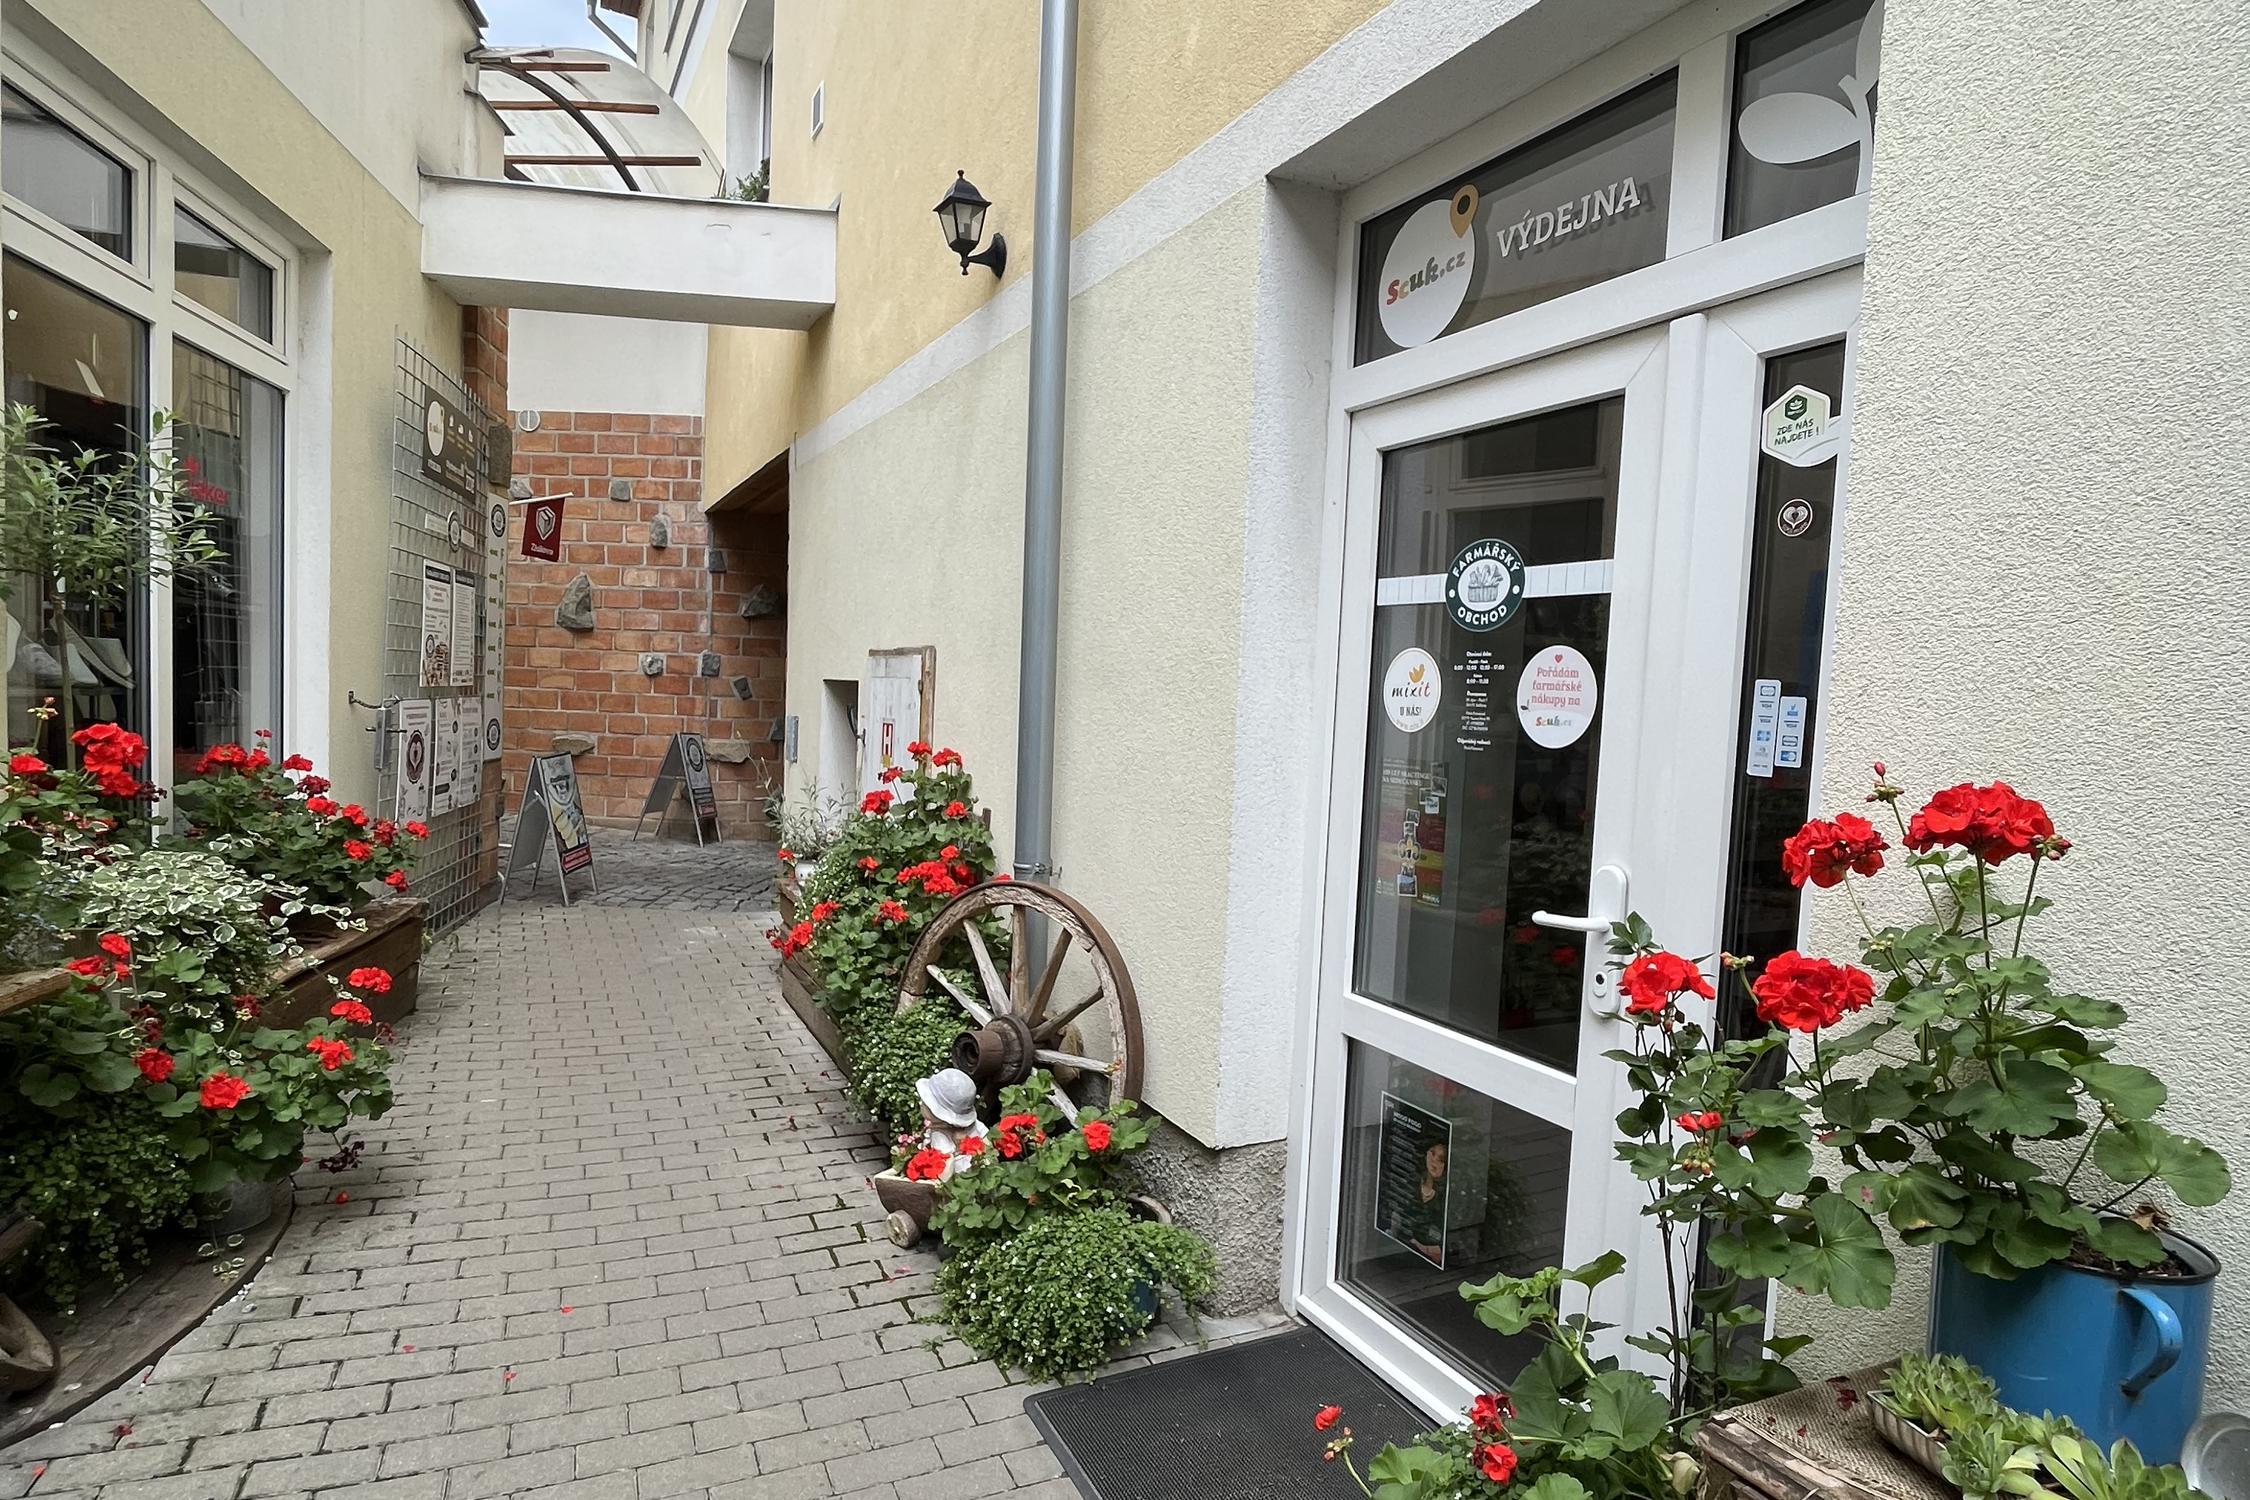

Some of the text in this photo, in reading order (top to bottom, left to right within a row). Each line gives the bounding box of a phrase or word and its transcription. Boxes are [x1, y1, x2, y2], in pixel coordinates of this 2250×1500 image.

[1496, 176, 1641, 258] VÝDEJNA
[1386, 251, 1466, 306] Scuk.cz
[1774, 429, 1813, 446] NAJDETE
[1777, 424, 1793, 436] ZDE
[1452, 542, 1521, 578] FARMÁŘSKÝ
[1457, 604, 1507, 625] OBCHOD
[1536, 667, 1579, 678] Pořádám
[1391, 682, 1431, 698] mixit
[1531, 693, 1580, 707] nákupy na
